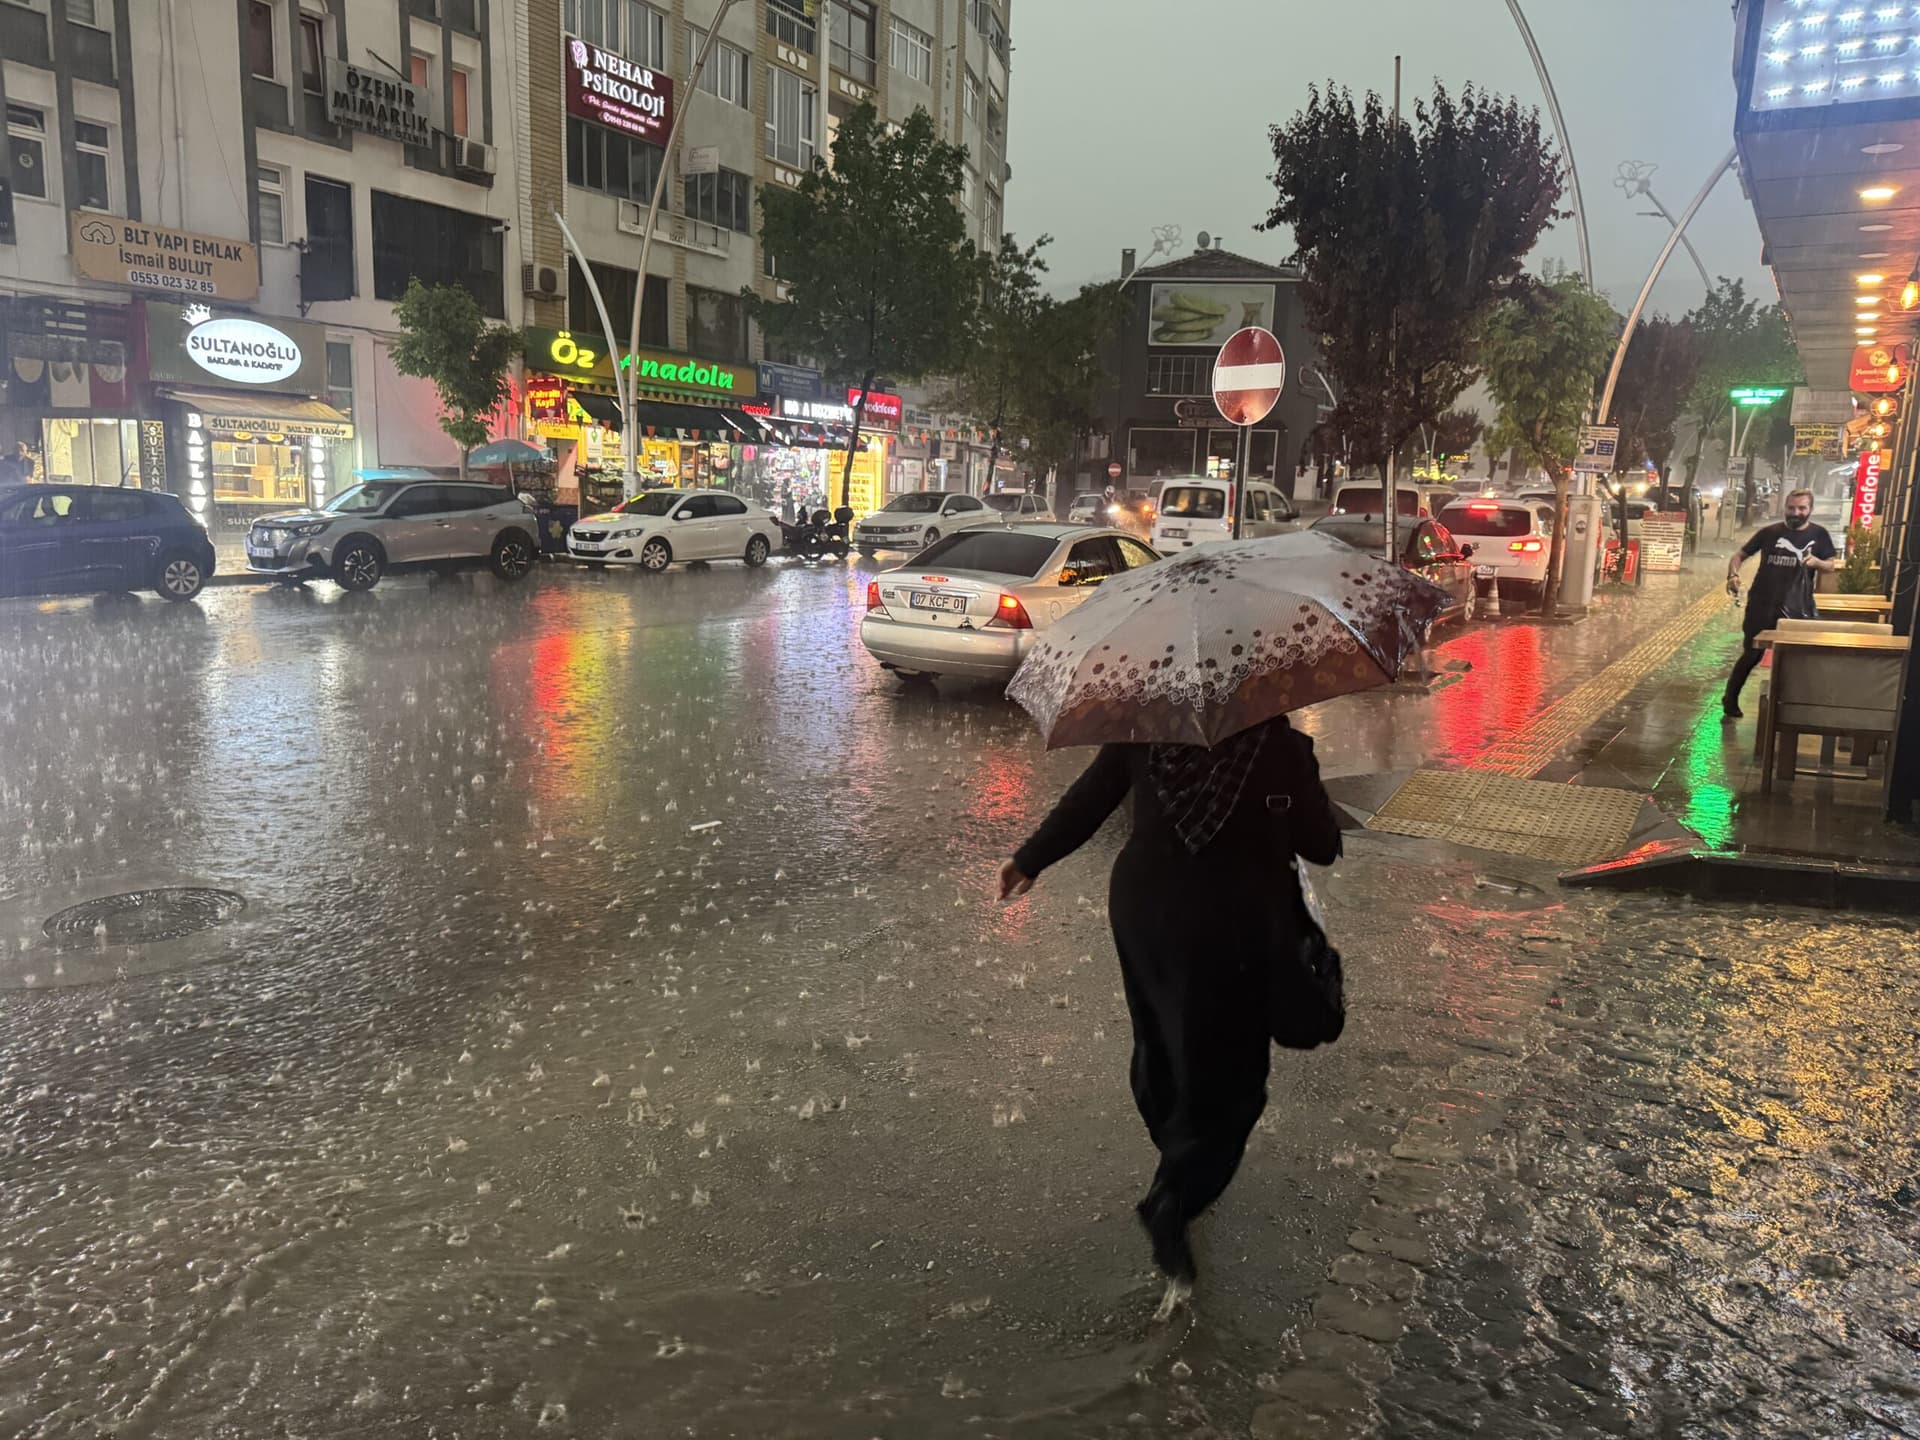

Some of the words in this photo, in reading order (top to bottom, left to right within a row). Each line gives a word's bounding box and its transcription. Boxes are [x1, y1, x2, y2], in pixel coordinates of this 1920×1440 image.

[593, 48, 655, 90] NEHAR
[346, 66, 415, 107] ÖZENİR
[582, 69, 665, 117] PSİKOLOJİ
[333, 91, 428, 134] MİMARLIK
[119, 243, 164, 269] İsmail
[169, 256, 213, 276] BULUT
[124, 226, 150, 246] BLT
[154, 232, 188, 252] YAPI
[193, 239, 243, 262] EMLAK
[131, 271, 159, 285] 0553
[162, 276, 182, 289] 023
[185, 279, 197, 291] 32
[201, 281, 214, 293] 85
[190, 335, 296, 361] SULTANOĞLU
[551, 331, 595, 368] Öz
[864, 401, 898, 416] vodafone
[1767, 554, 1797, 567] PUMA
[915, 594, 925, 603] 07
[929, 596, 950, 608] KCF
[953, 598, 963, 609] 01
